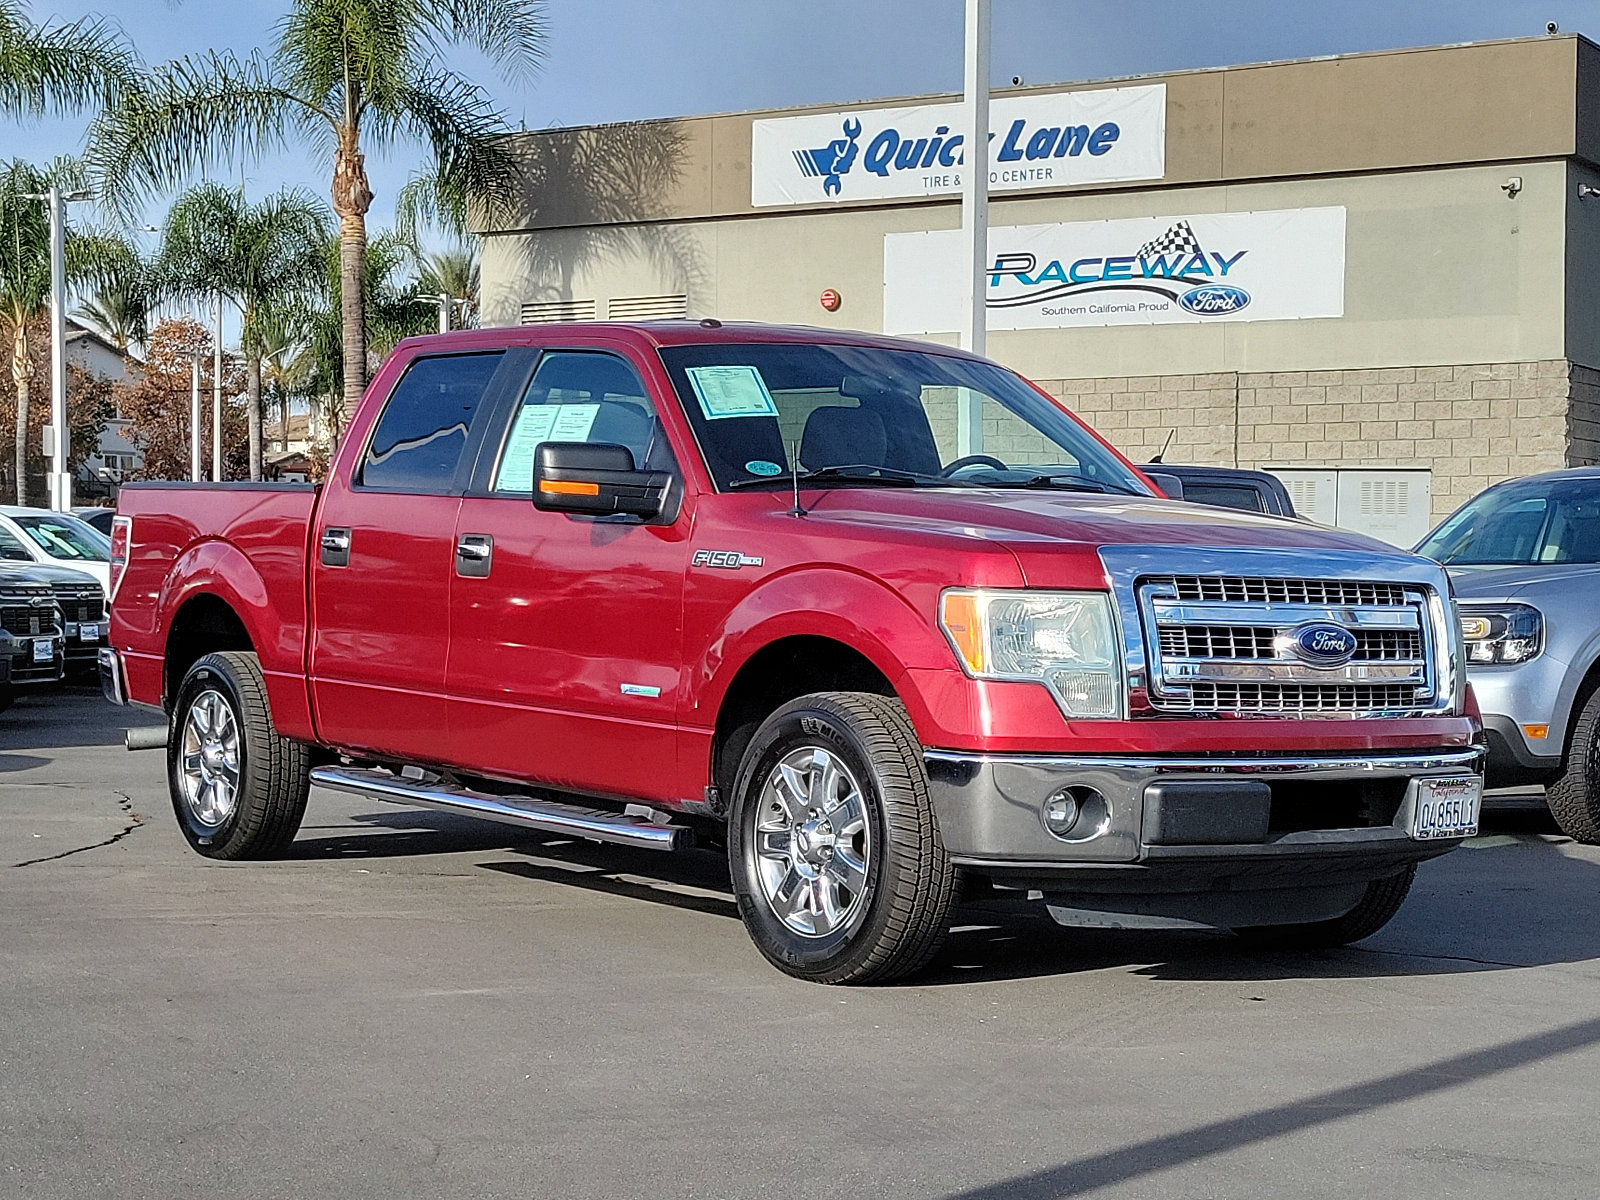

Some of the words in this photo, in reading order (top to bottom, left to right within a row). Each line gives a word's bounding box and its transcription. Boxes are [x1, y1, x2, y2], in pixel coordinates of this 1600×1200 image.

[864, 126, 996, 176] Quic
[997, 119, 1120, 162] Lane
[922, 175, 950, 188] TIRE
[953, 174, 961, 186] &
[1002, 168, 1053, 182] CENTER
[988, 250, 1249, 287] RACEWAY
[1041, 306, 1086, 316] Southern
[1088, 303, 1136, 315] California
[1138, 301, 1169, 312] Proud
[1191, 289, 1238, 311] Ford
[1312, 631, 1347, 651] Ford
[1421, 799, 1474, 829] 04855L1
